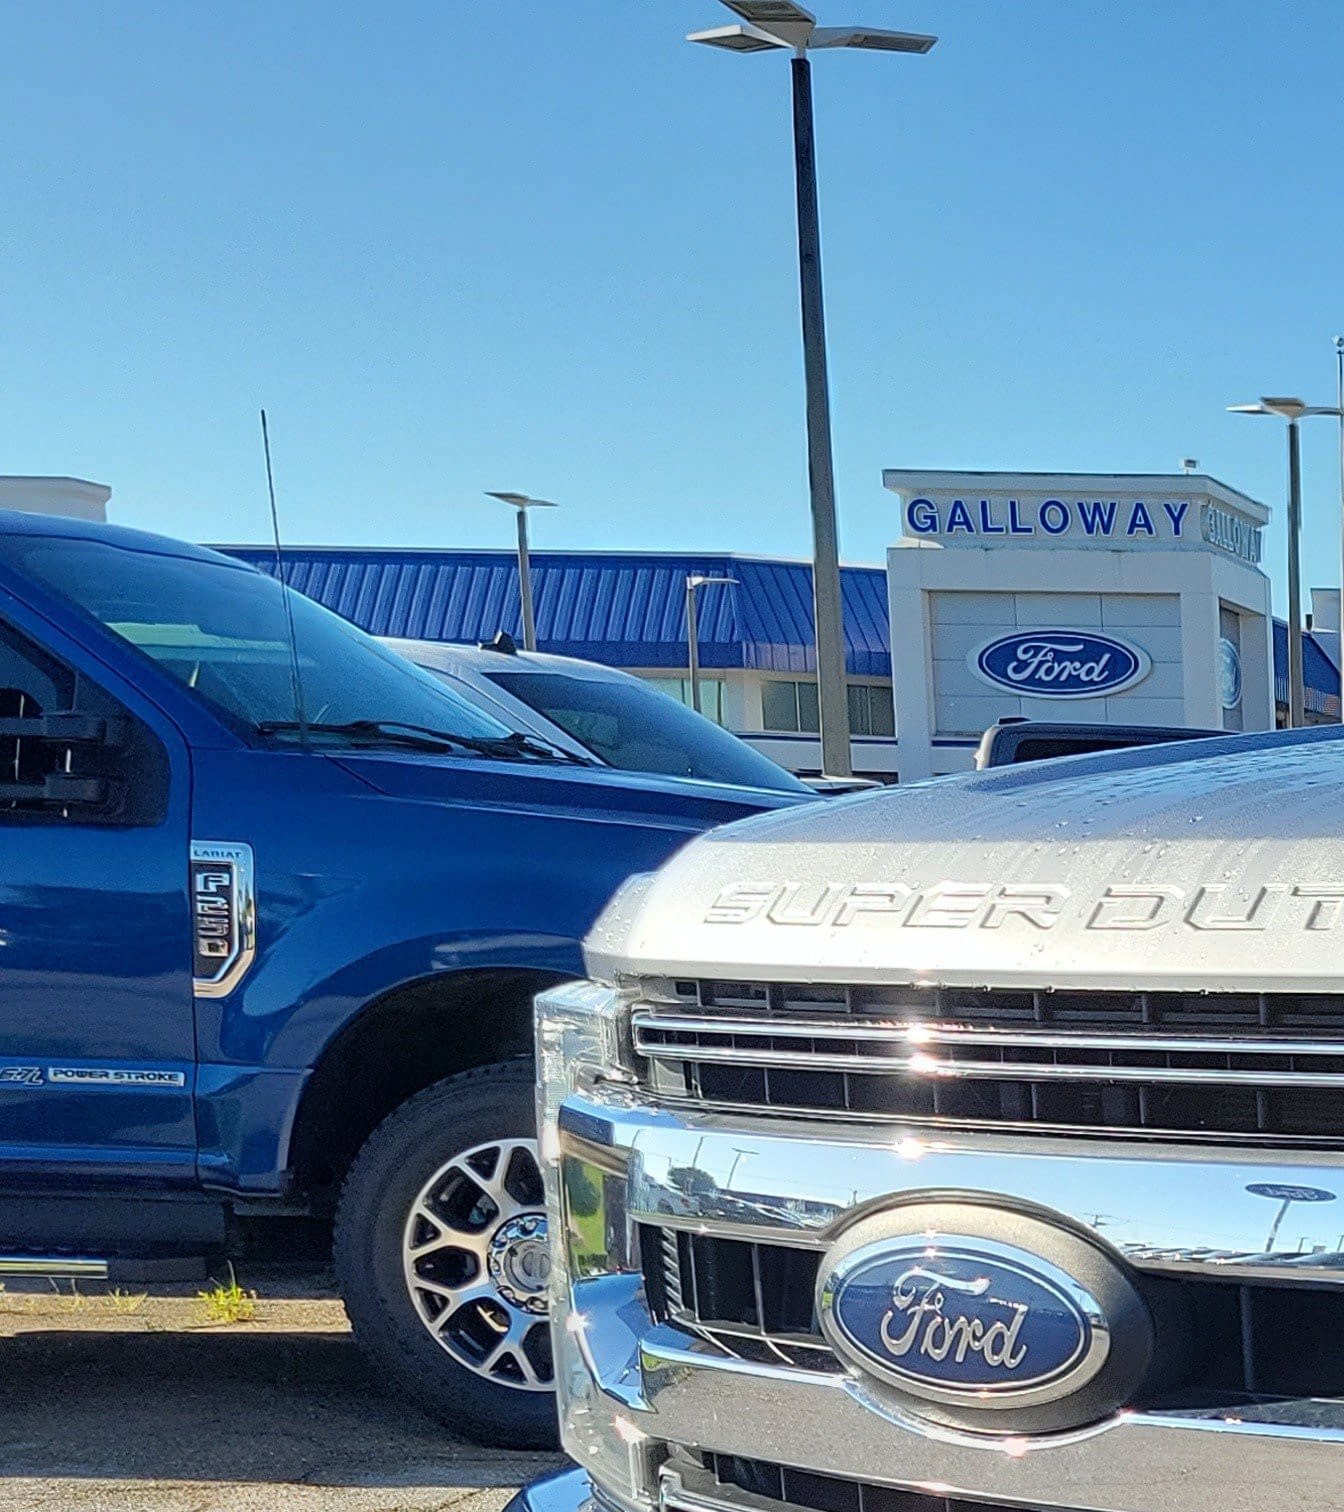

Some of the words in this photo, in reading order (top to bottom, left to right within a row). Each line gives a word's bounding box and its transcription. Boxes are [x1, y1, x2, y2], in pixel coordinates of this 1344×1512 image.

[907, 498, 1189, 538] GALLOWAY
[1006, 641, 1112, 682] Ford
[193, 850, 242, 859] LARIAT
[702, 877, 1073, 931] SUPER
[53, 1069, 110, 1080] POWER
[112, 1070, 179, 1082] STROKE
[880, 1265, 1030, 1370] Ford
